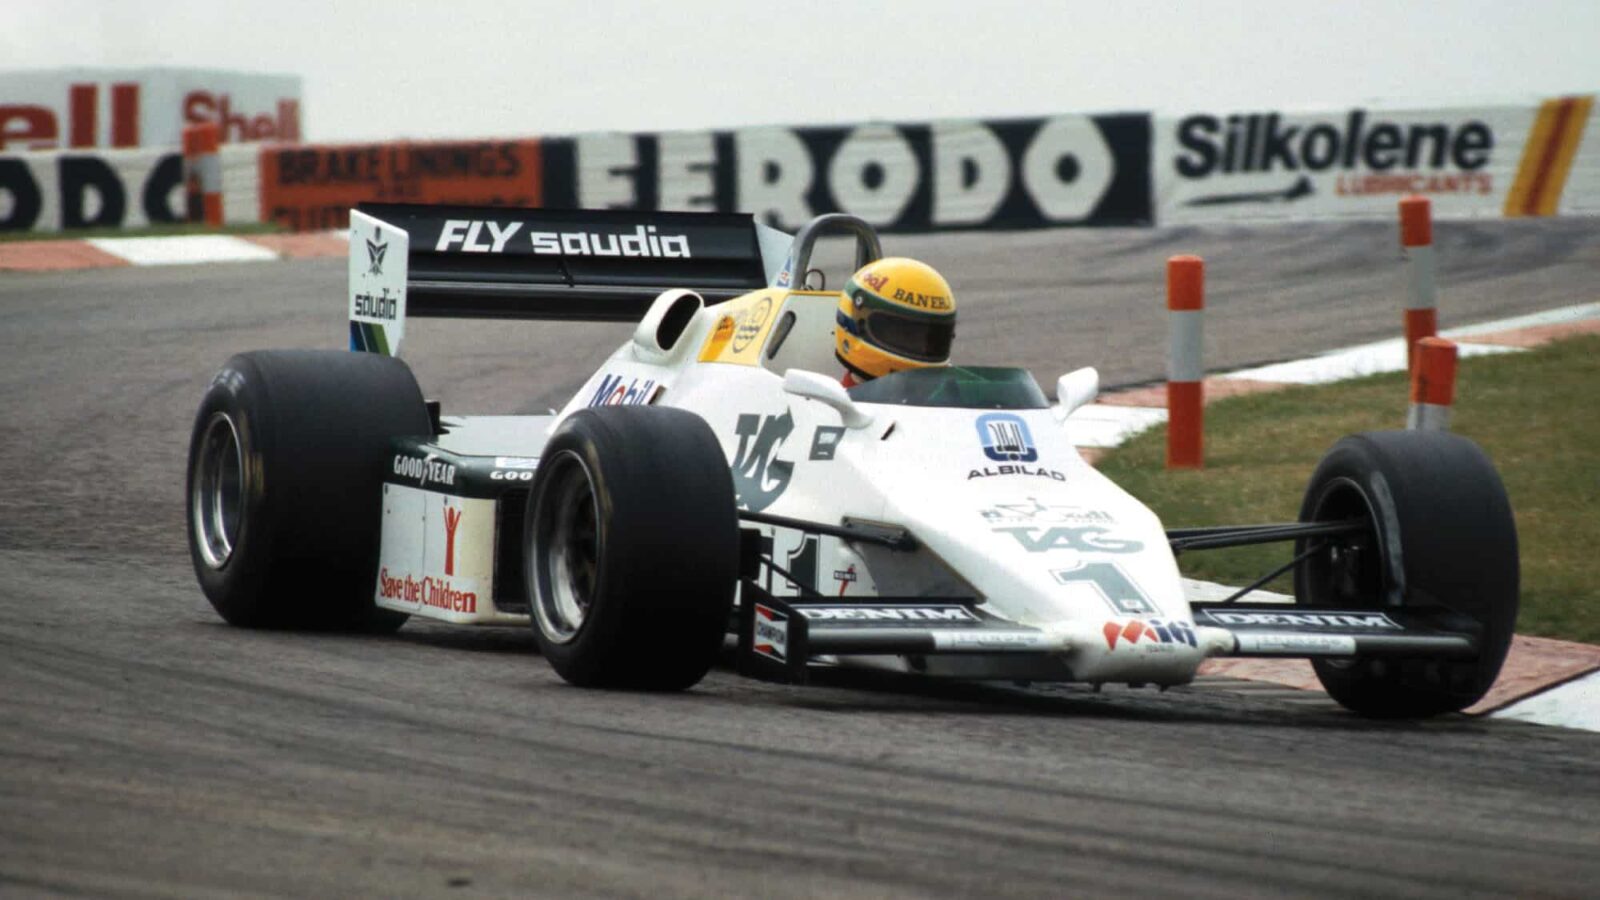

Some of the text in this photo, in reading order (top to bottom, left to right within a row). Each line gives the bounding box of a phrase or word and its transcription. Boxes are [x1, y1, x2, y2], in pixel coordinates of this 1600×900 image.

[1175, 109, 1493, 178] Silkolene
[576, 115, 1116, 227] FERODO
[435, 220, 691, 258] FLY saudia
[355, 289, 397, 320] saudia
[967, 465, 1066, 481] ALBILAD
[380, 567, 477, 613] Save the Children
[1050, 560, 1163, 616] 1
[1213, 613, 1391, 627] DENIM
